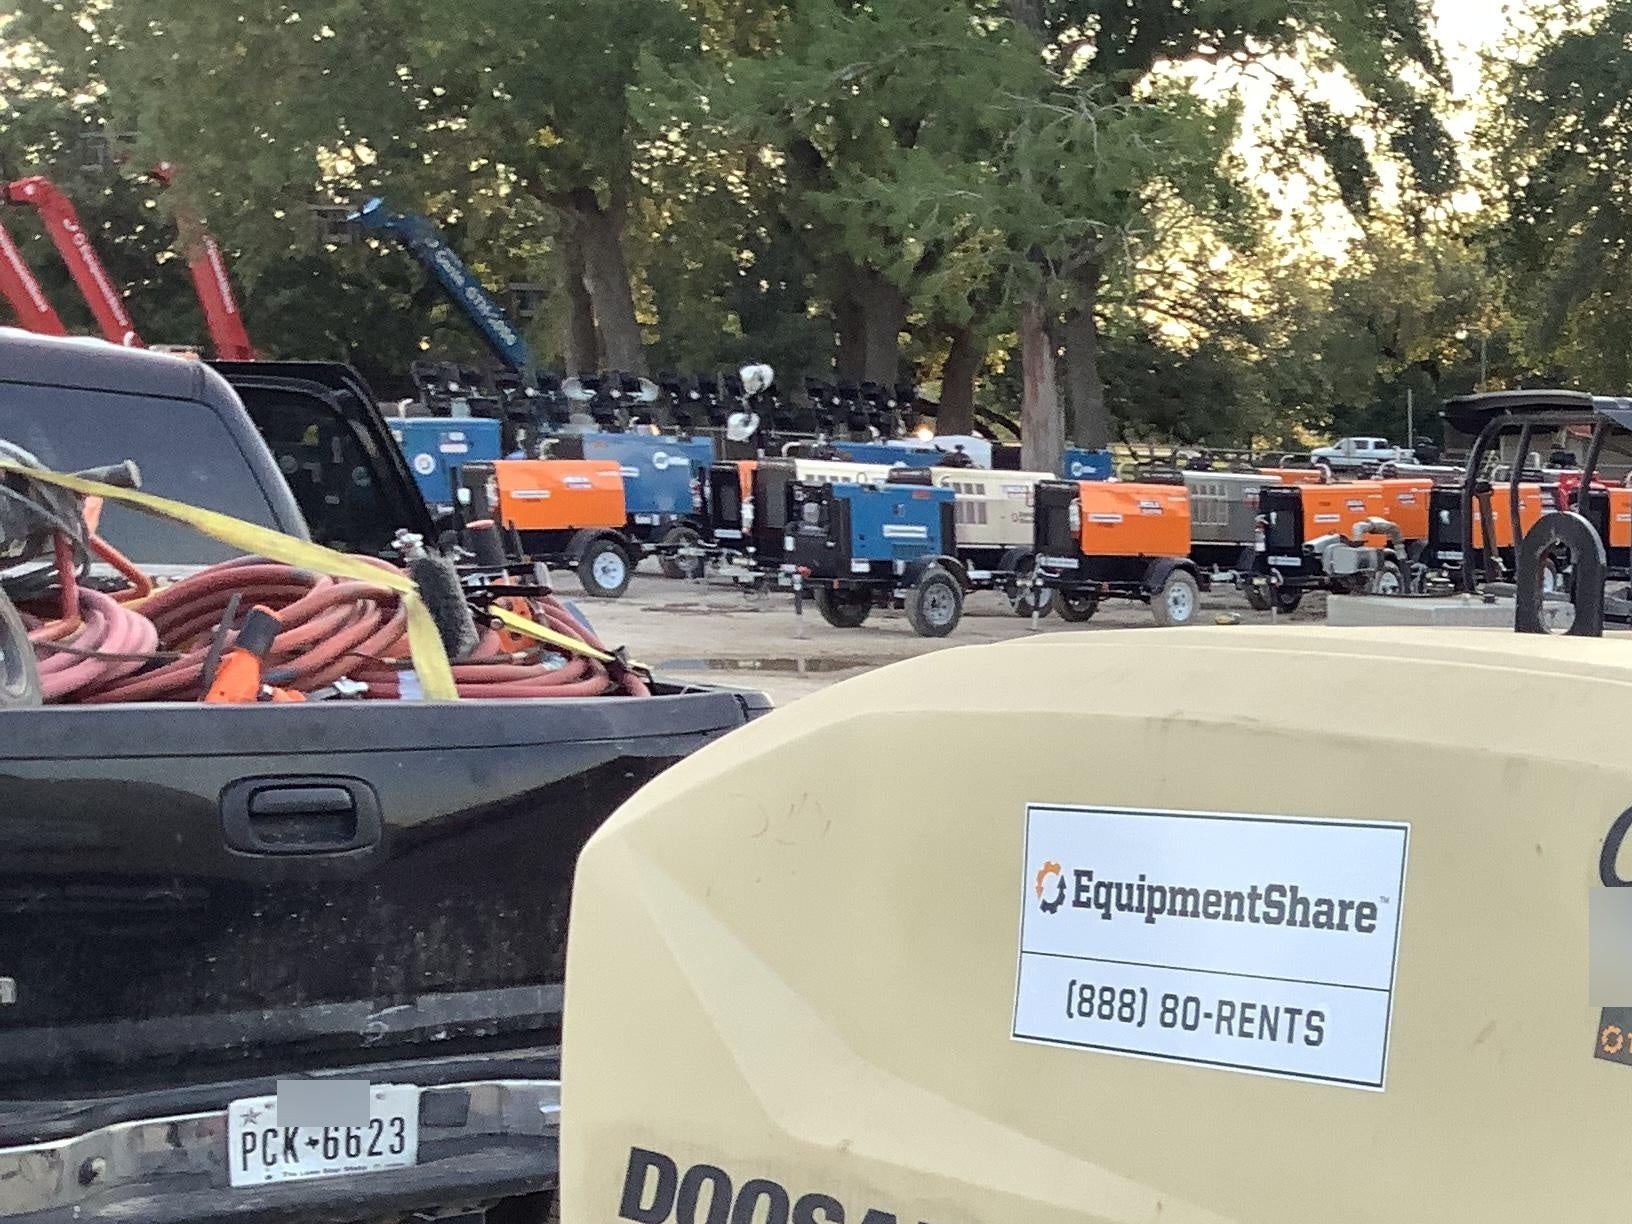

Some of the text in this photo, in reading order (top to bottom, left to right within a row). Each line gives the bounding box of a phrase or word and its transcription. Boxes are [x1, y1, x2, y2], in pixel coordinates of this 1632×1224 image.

[1072, 869, 1379, 934] EquipmentShare
[1065, 978, 1326, 1048] (888) 80-RENTS
